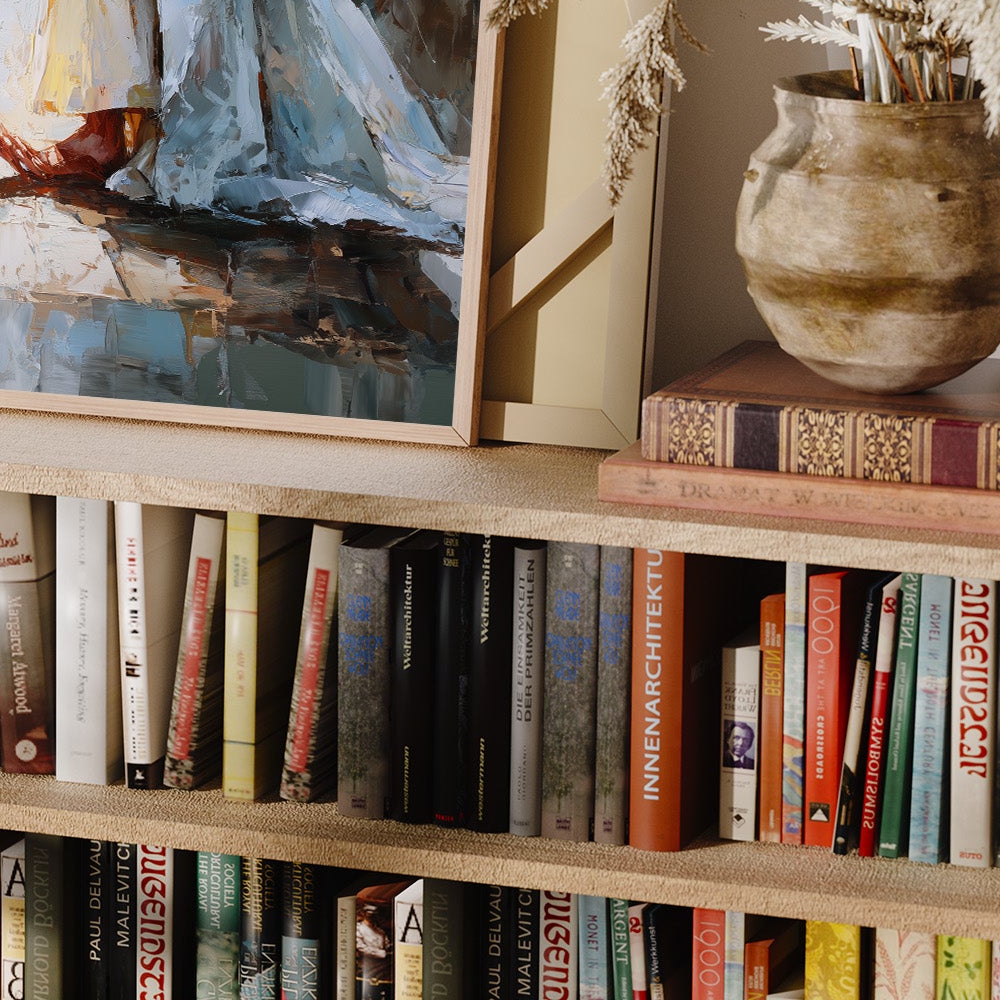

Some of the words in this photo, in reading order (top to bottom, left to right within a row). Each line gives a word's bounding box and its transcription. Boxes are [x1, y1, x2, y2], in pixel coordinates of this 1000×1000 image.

[6, 594, 24, 659] Margaret
[403, 564, 413, 671] Weltarchitektur
[515, 575, 526, 688] EINSAMKEIT
[523, 559, 535, 681] PRIMZAHLEN
[12, 660, 32, 715] Atwood
[515, 694, 525, 722] DIE
[523, 692, 534, 722] DER
[643, 549, 664, 801] INNENARCHITEKTU
[477, 738, 486, 821] westermann
[4, 857, 25, 897] A
[90, 839, 101, 910] DELVAU
[90, 917, 101, 961] PAUL
[140, 845, 166, 1000] JUGENDST
[400, 903, 423, 943] A
[488, 885, 501, 962] DELVAU
[587, 914, 598, 952] MONET
[611, 899, 629, 966] ARGENT
[650, 926, 660, 975] Werkkunst
[694, 920, 722, 987] 1900
